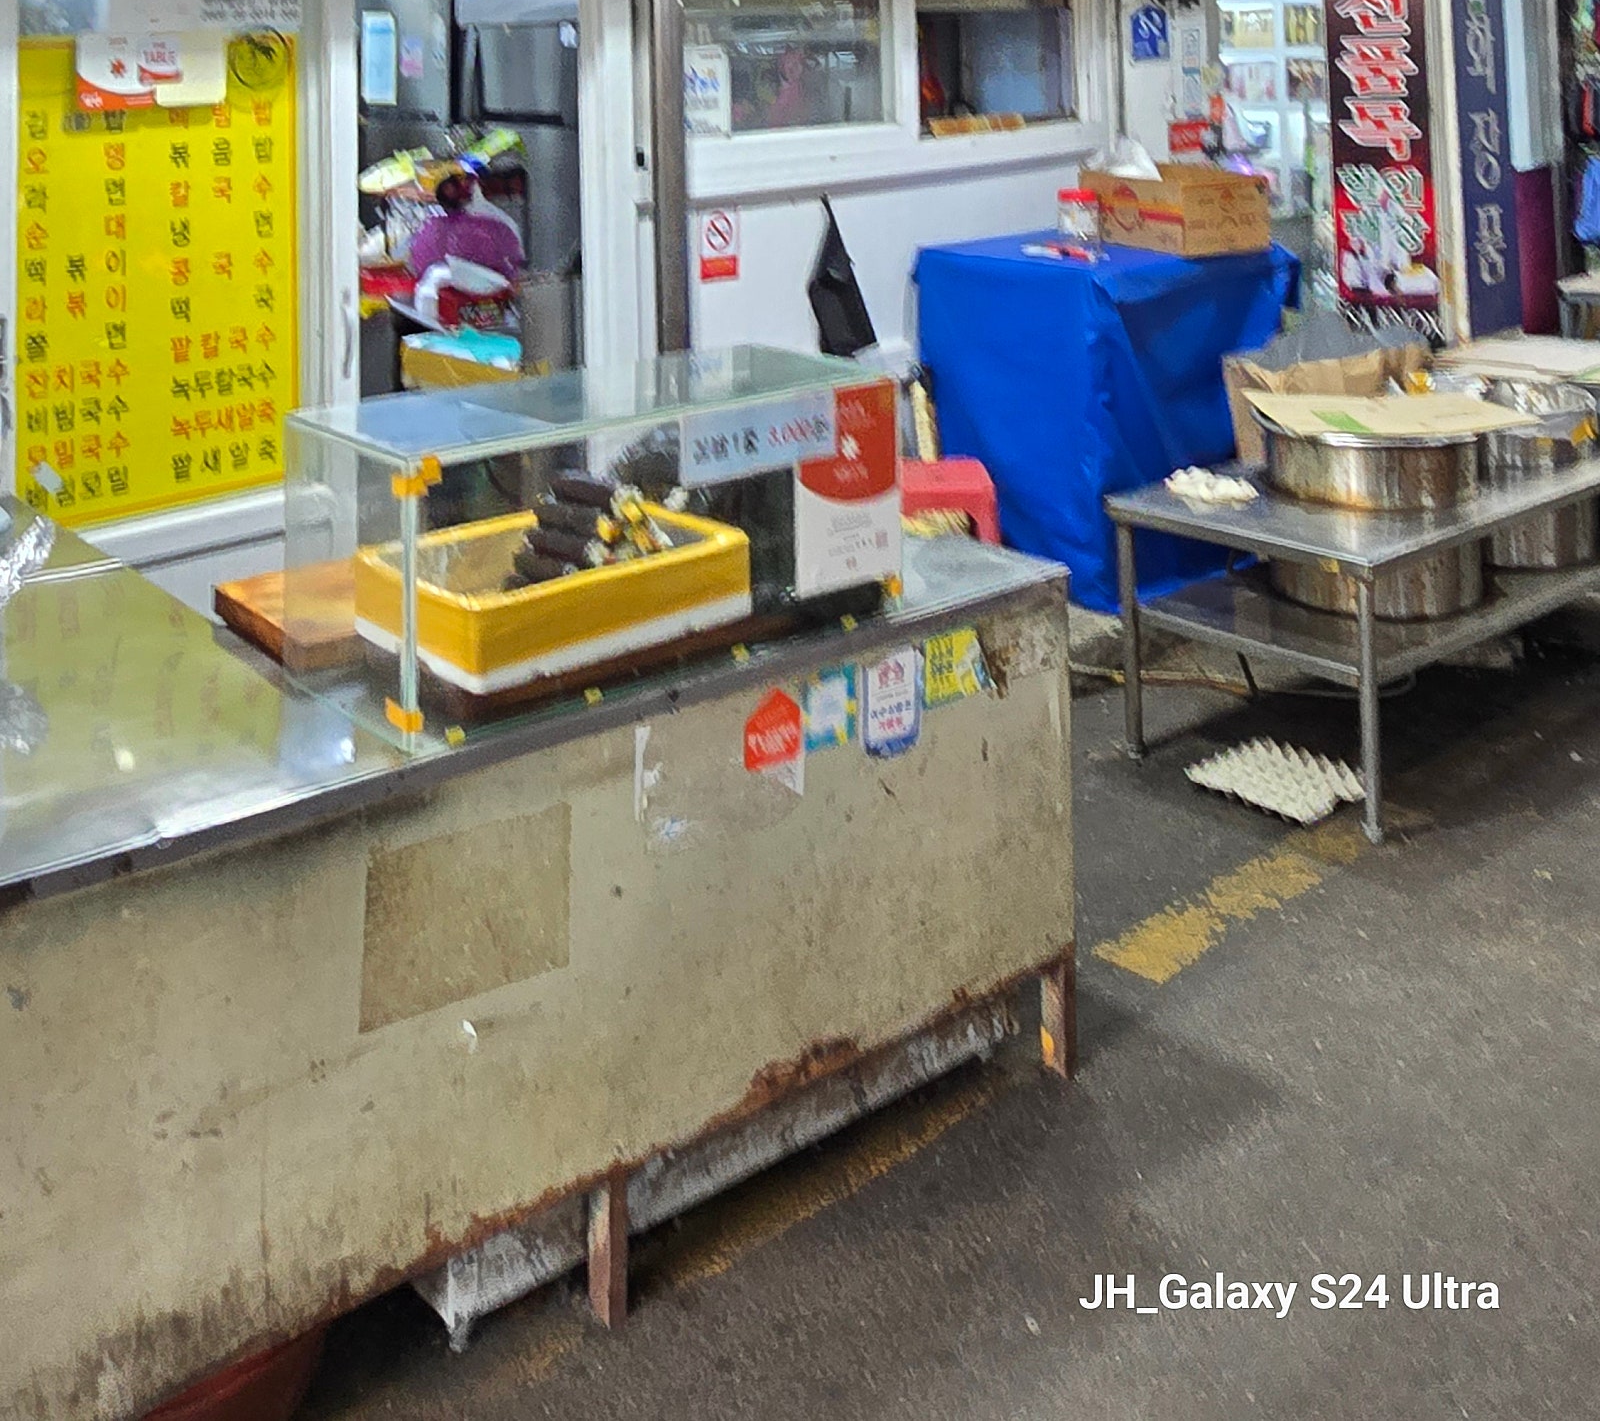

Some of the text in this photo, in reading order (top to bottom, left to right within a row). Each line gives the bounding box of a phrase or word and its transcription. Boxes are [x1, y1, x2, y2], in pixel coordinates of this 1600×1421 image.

[169, 136, 273, 169] 볶음밥
[1464, 9, 1511, 286] 화장품
[169, 210, 273, 247] 냉면
[25, 248, 127, 286] 떡볶이
[25, 358, 130, 400] 잔치국수
